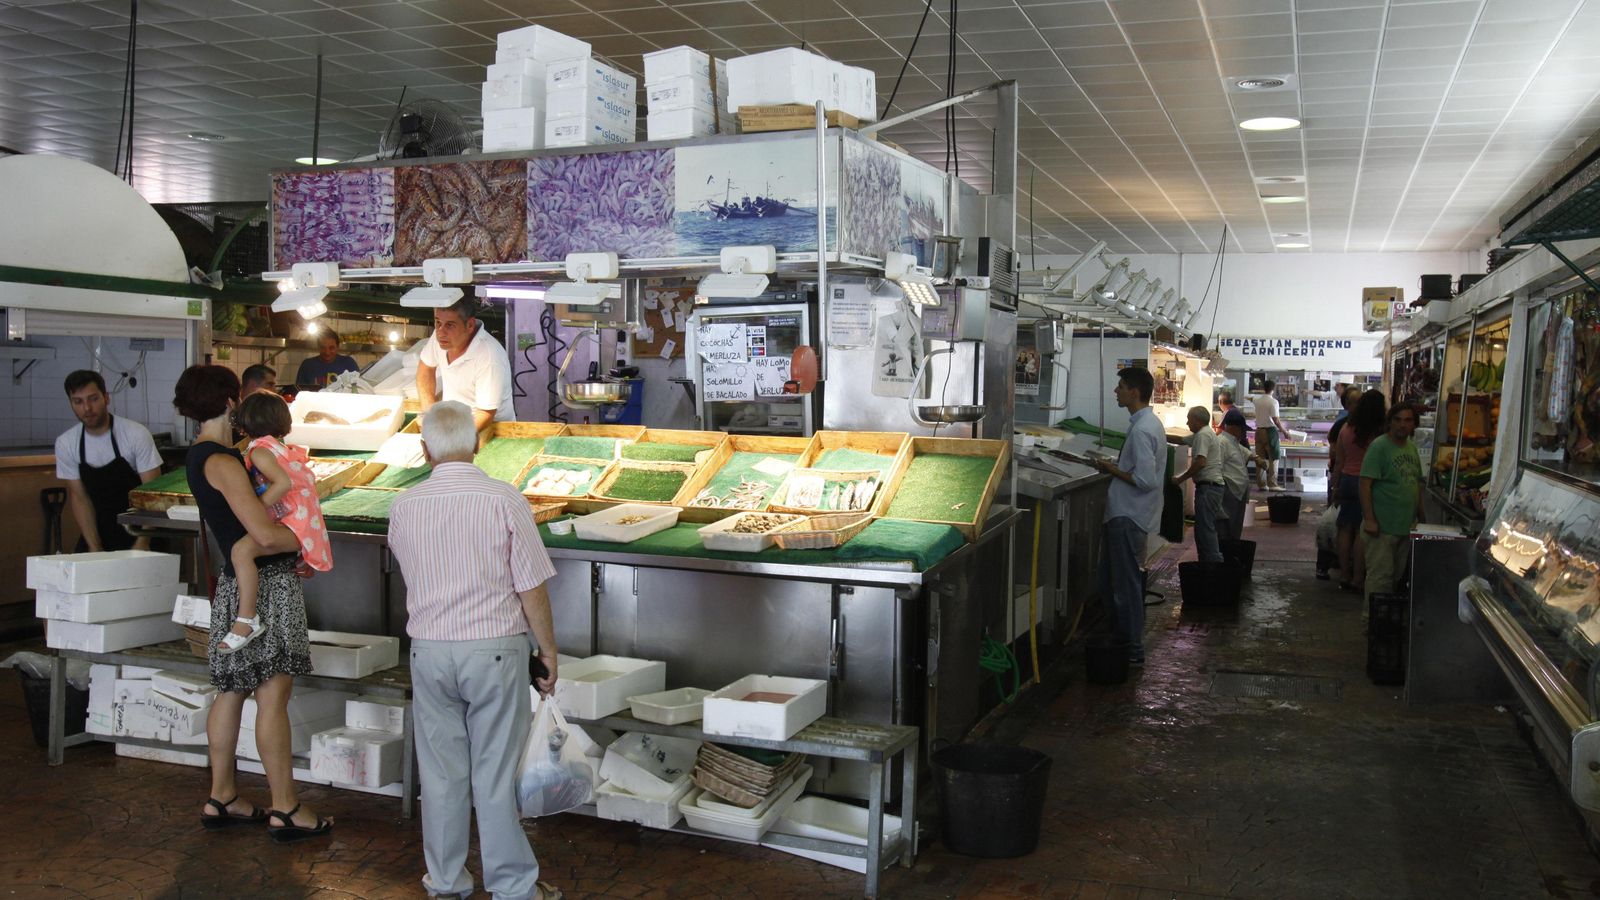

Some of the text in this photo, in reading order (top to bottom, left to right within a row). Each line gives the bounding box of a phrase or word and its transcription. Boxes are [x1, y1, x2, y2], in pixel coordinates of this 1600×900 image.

[602, 73, 629, 91] islasur
[604, 100, 631, 117] islasur
[1301, 340, 1351, 349] MORENO
[709, 352, 741, 360] MERLUZA
[1242, 347, 1325, 356] CARNICERIA
[756, 358, 789, 367] HAY LOMO
[757, 373, 764, 381] DE
[706, 378, 742, 386] SOLOMILLO
[715, 391, 747, 399] BACALADO
